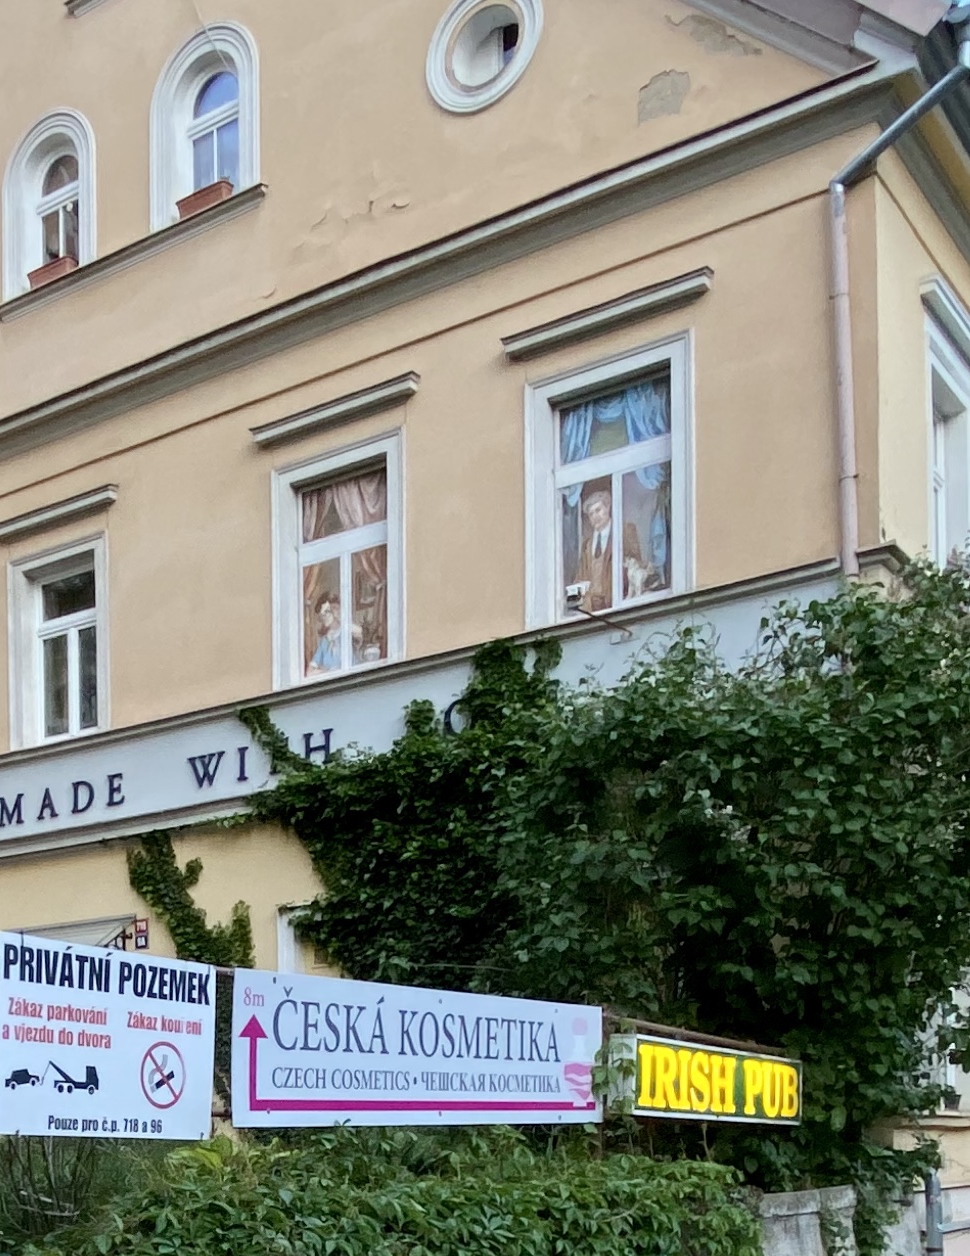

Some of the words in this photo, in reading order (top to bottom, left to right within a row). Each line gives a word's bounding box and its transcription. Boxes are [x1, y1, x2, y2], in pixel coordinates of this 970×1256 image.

[3, 943, 111, 993] PRIVÁTNÍ
[118, 961, 210, 1006] POZEMEK
[243, 987, 265, 1007] 8m
[8, 997, 43, 1019] Zákaz
[47, 1003, 108, 1026] parkování
[127, 1010, 158, 1031] Zákaz
[2, 1024, 10, 1040] a
[14, 1023, 54, 1044] vjezdu
[58, 1027, 74, 1046] do
[77, 1029, 112, 1049] dvora
[272, 986, 389, 1055] ČESKÁ
[398, 1009, 561, 1063] KOSMETIKA
[272, 1066, 327, 1089] CZECH
[331, 1068, 411, 1091] COSMETICS
[421, 1071, 486, 1092] ЧЕШСКАЯ
[489, 1073, 561, 1093] КОСМЕТИКА
[638, 1043, 736, 1114] IRISH
[743, 1059, 799, 1118] PUB
[48, 1115, 79, 1130] Pouze
[82, 1119, 99, 1132] pro
[123, 1118, 139, 1133] 718
[142, 1121, 148, 1133] a
[150, 1119, 163, 1133] 96
